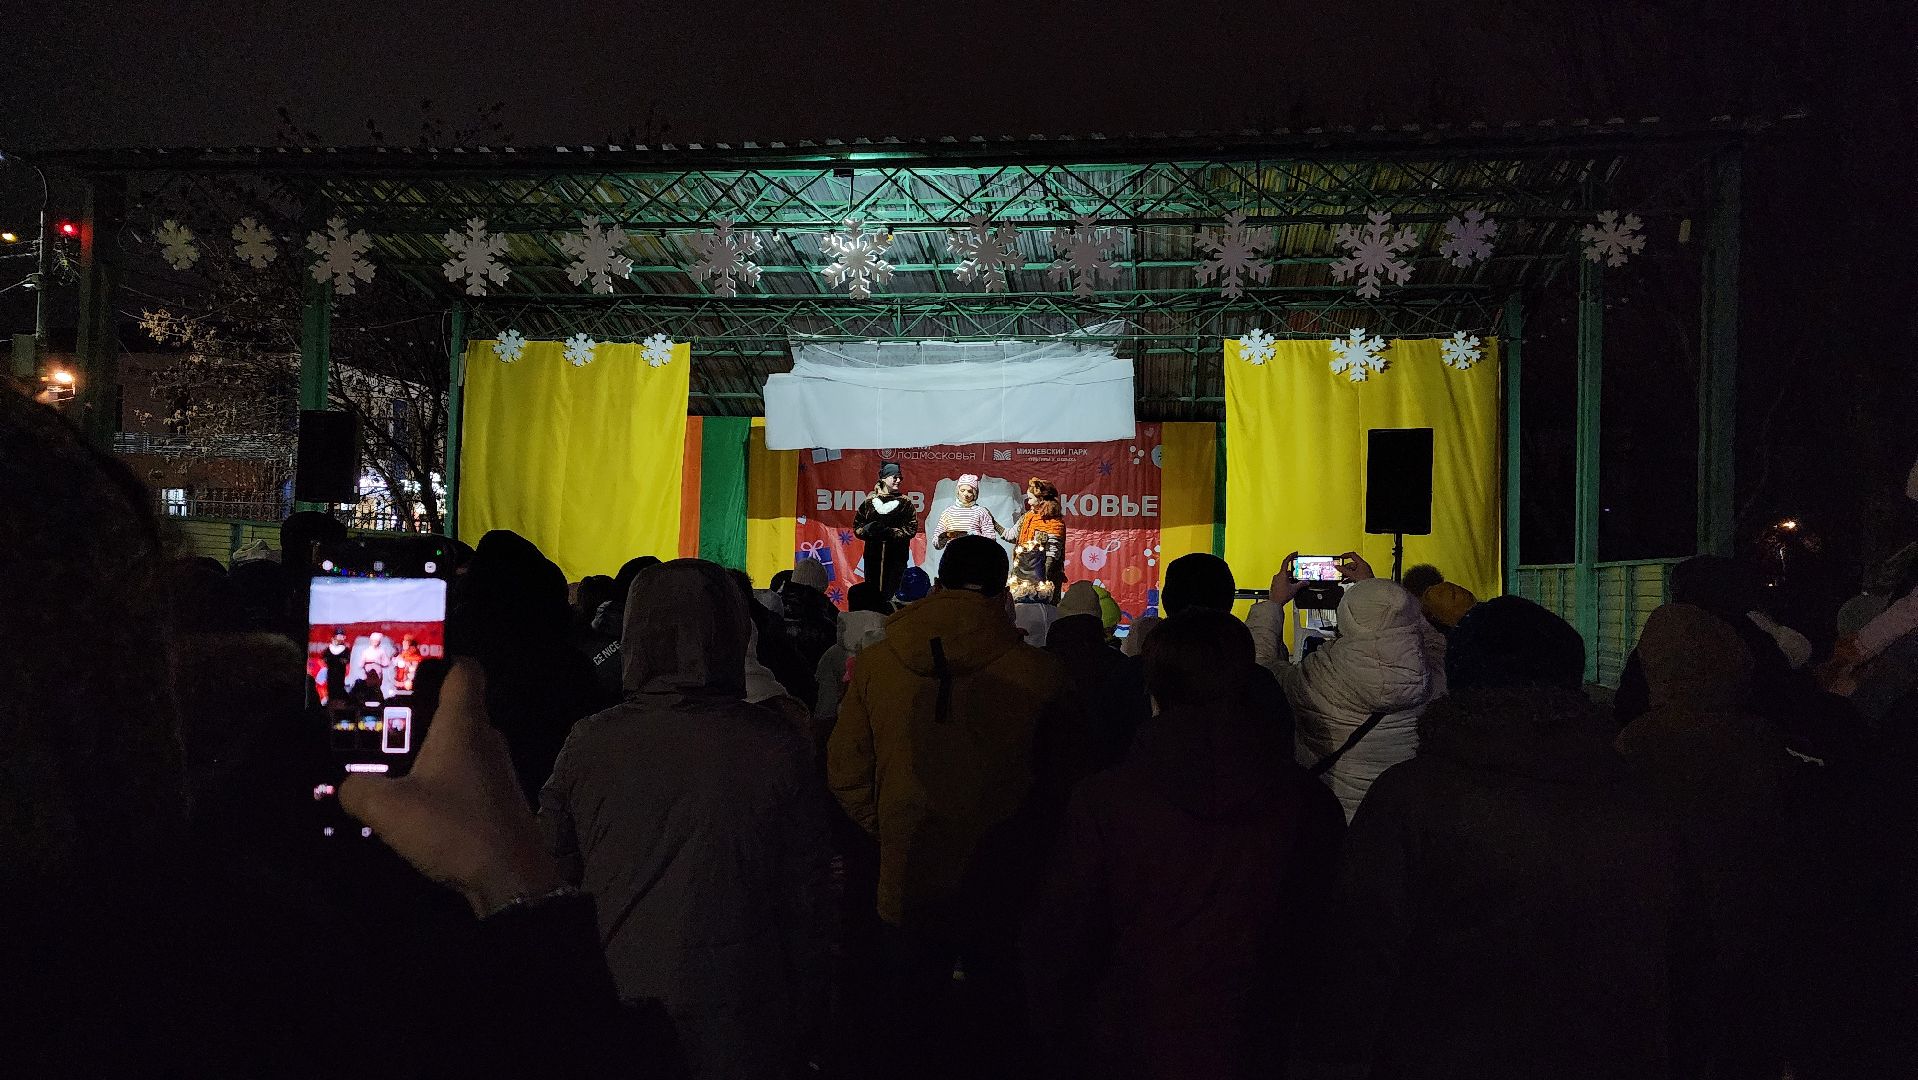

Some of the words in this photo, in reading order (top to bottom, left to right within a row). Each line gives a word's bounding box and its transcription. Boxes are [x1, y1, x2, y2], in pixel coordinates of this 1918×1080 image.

[897, 451, 976, 460] ПОДМОСКОВЬЯ
[1016, 447, 1066, 455] МИХНЕВСКИЙ
[1069, 448, 1088, 456] ПАРК
[907, 491, 925, 513] В
[1059, 493, 1158, 517] КОВЬЕ
